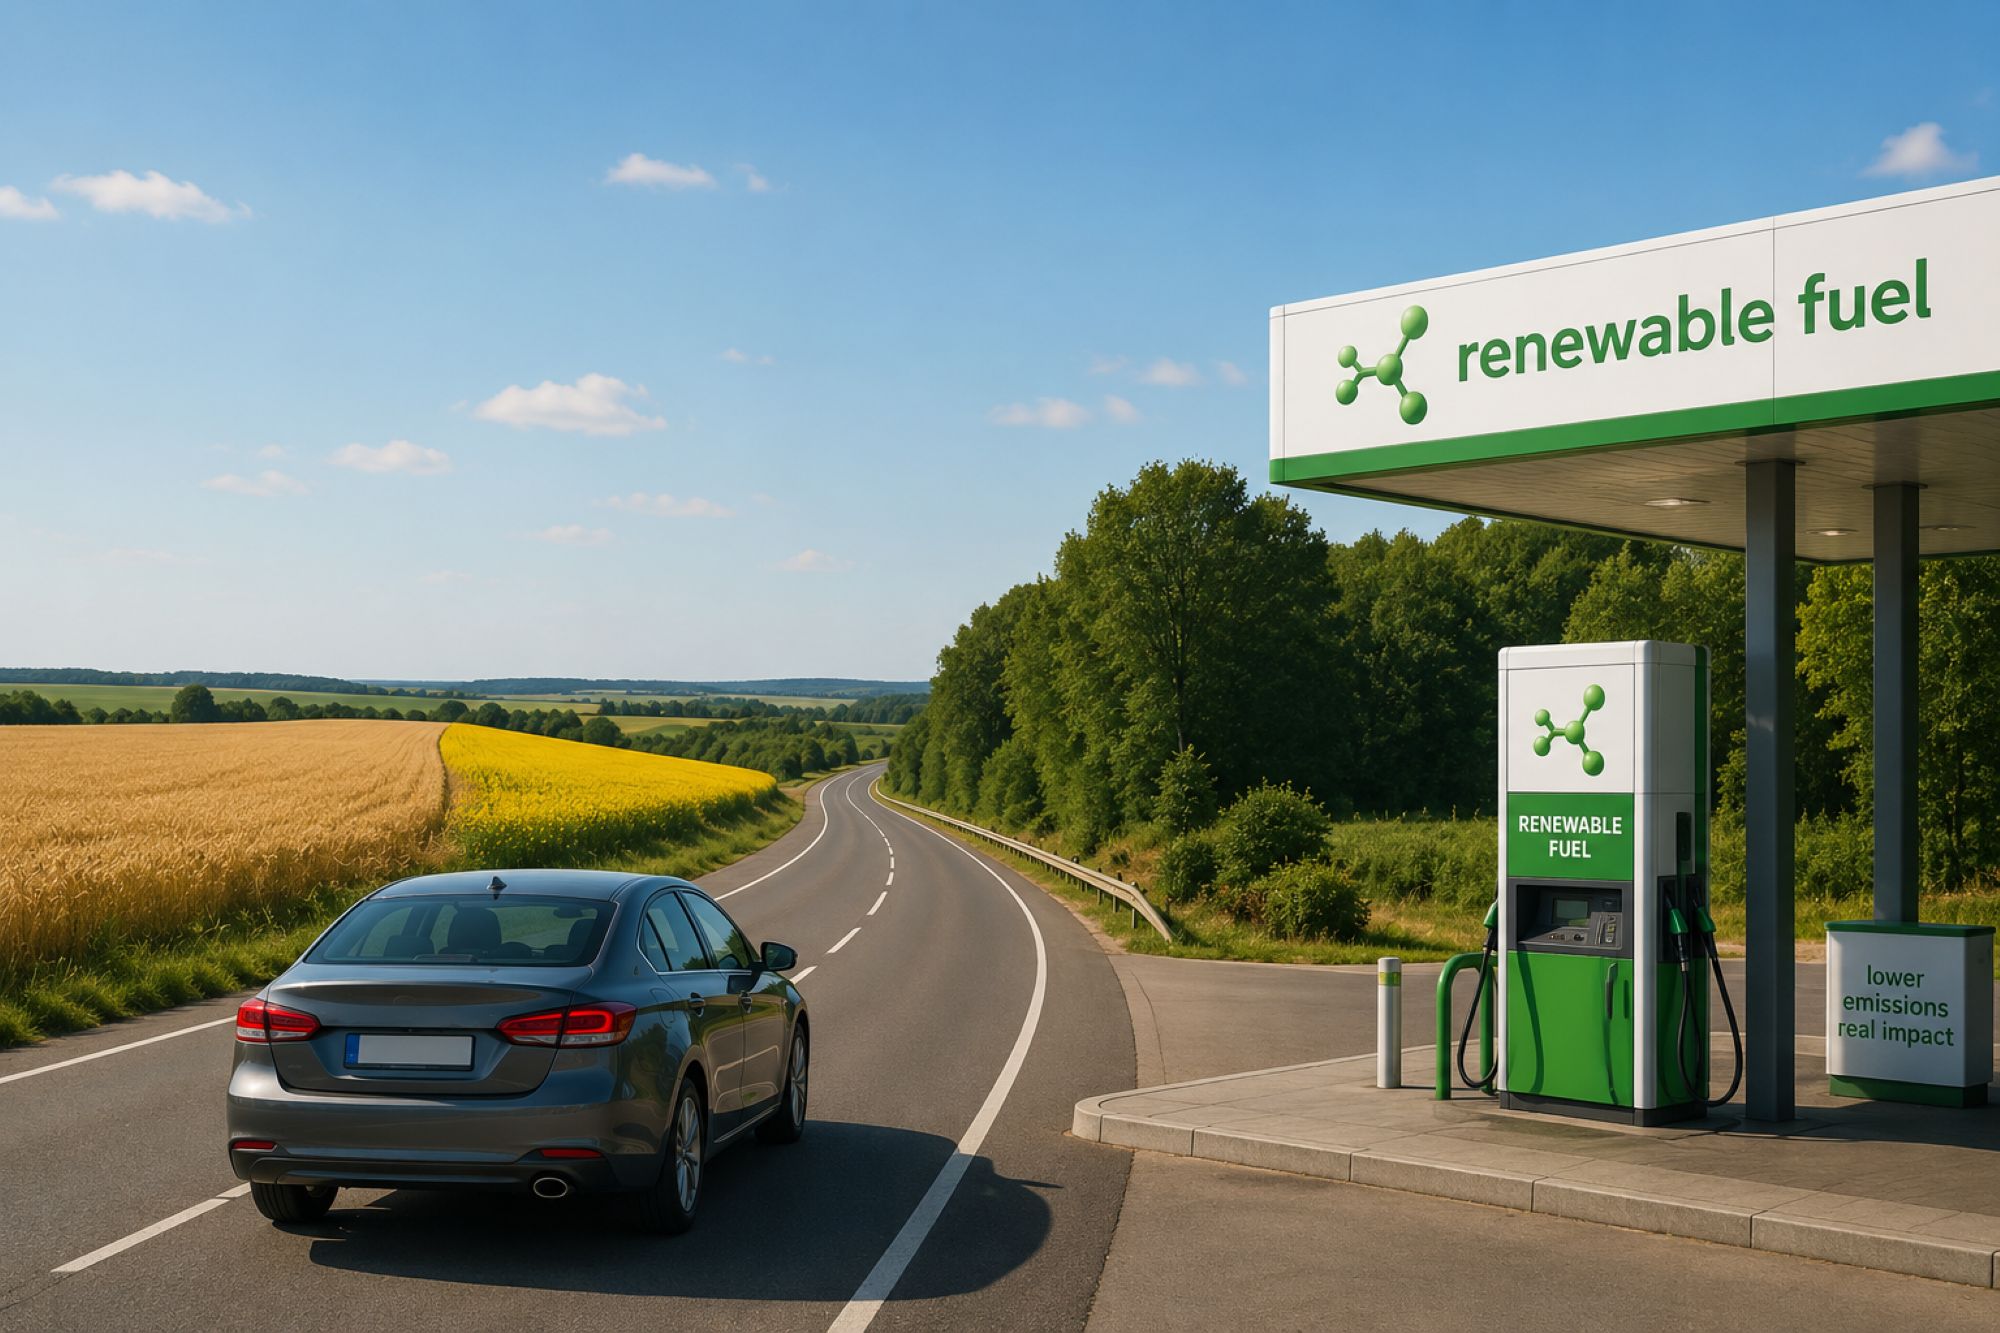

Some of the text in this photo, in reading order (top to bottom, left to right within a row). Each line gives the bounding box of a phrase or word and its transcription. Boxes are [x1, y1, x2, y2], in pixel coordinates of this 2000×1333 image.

[1458, 257, 1932, 382] renewable fuel
[1518, 815, 1623, 835] RENEWABLE
[1549, 840, 1592, 859] FUEL
[1867, 964, 1925, 988] lower
[1843, 993, 1949, 1018] emissions
[1838, 1019, 1954, 1048] real impact
